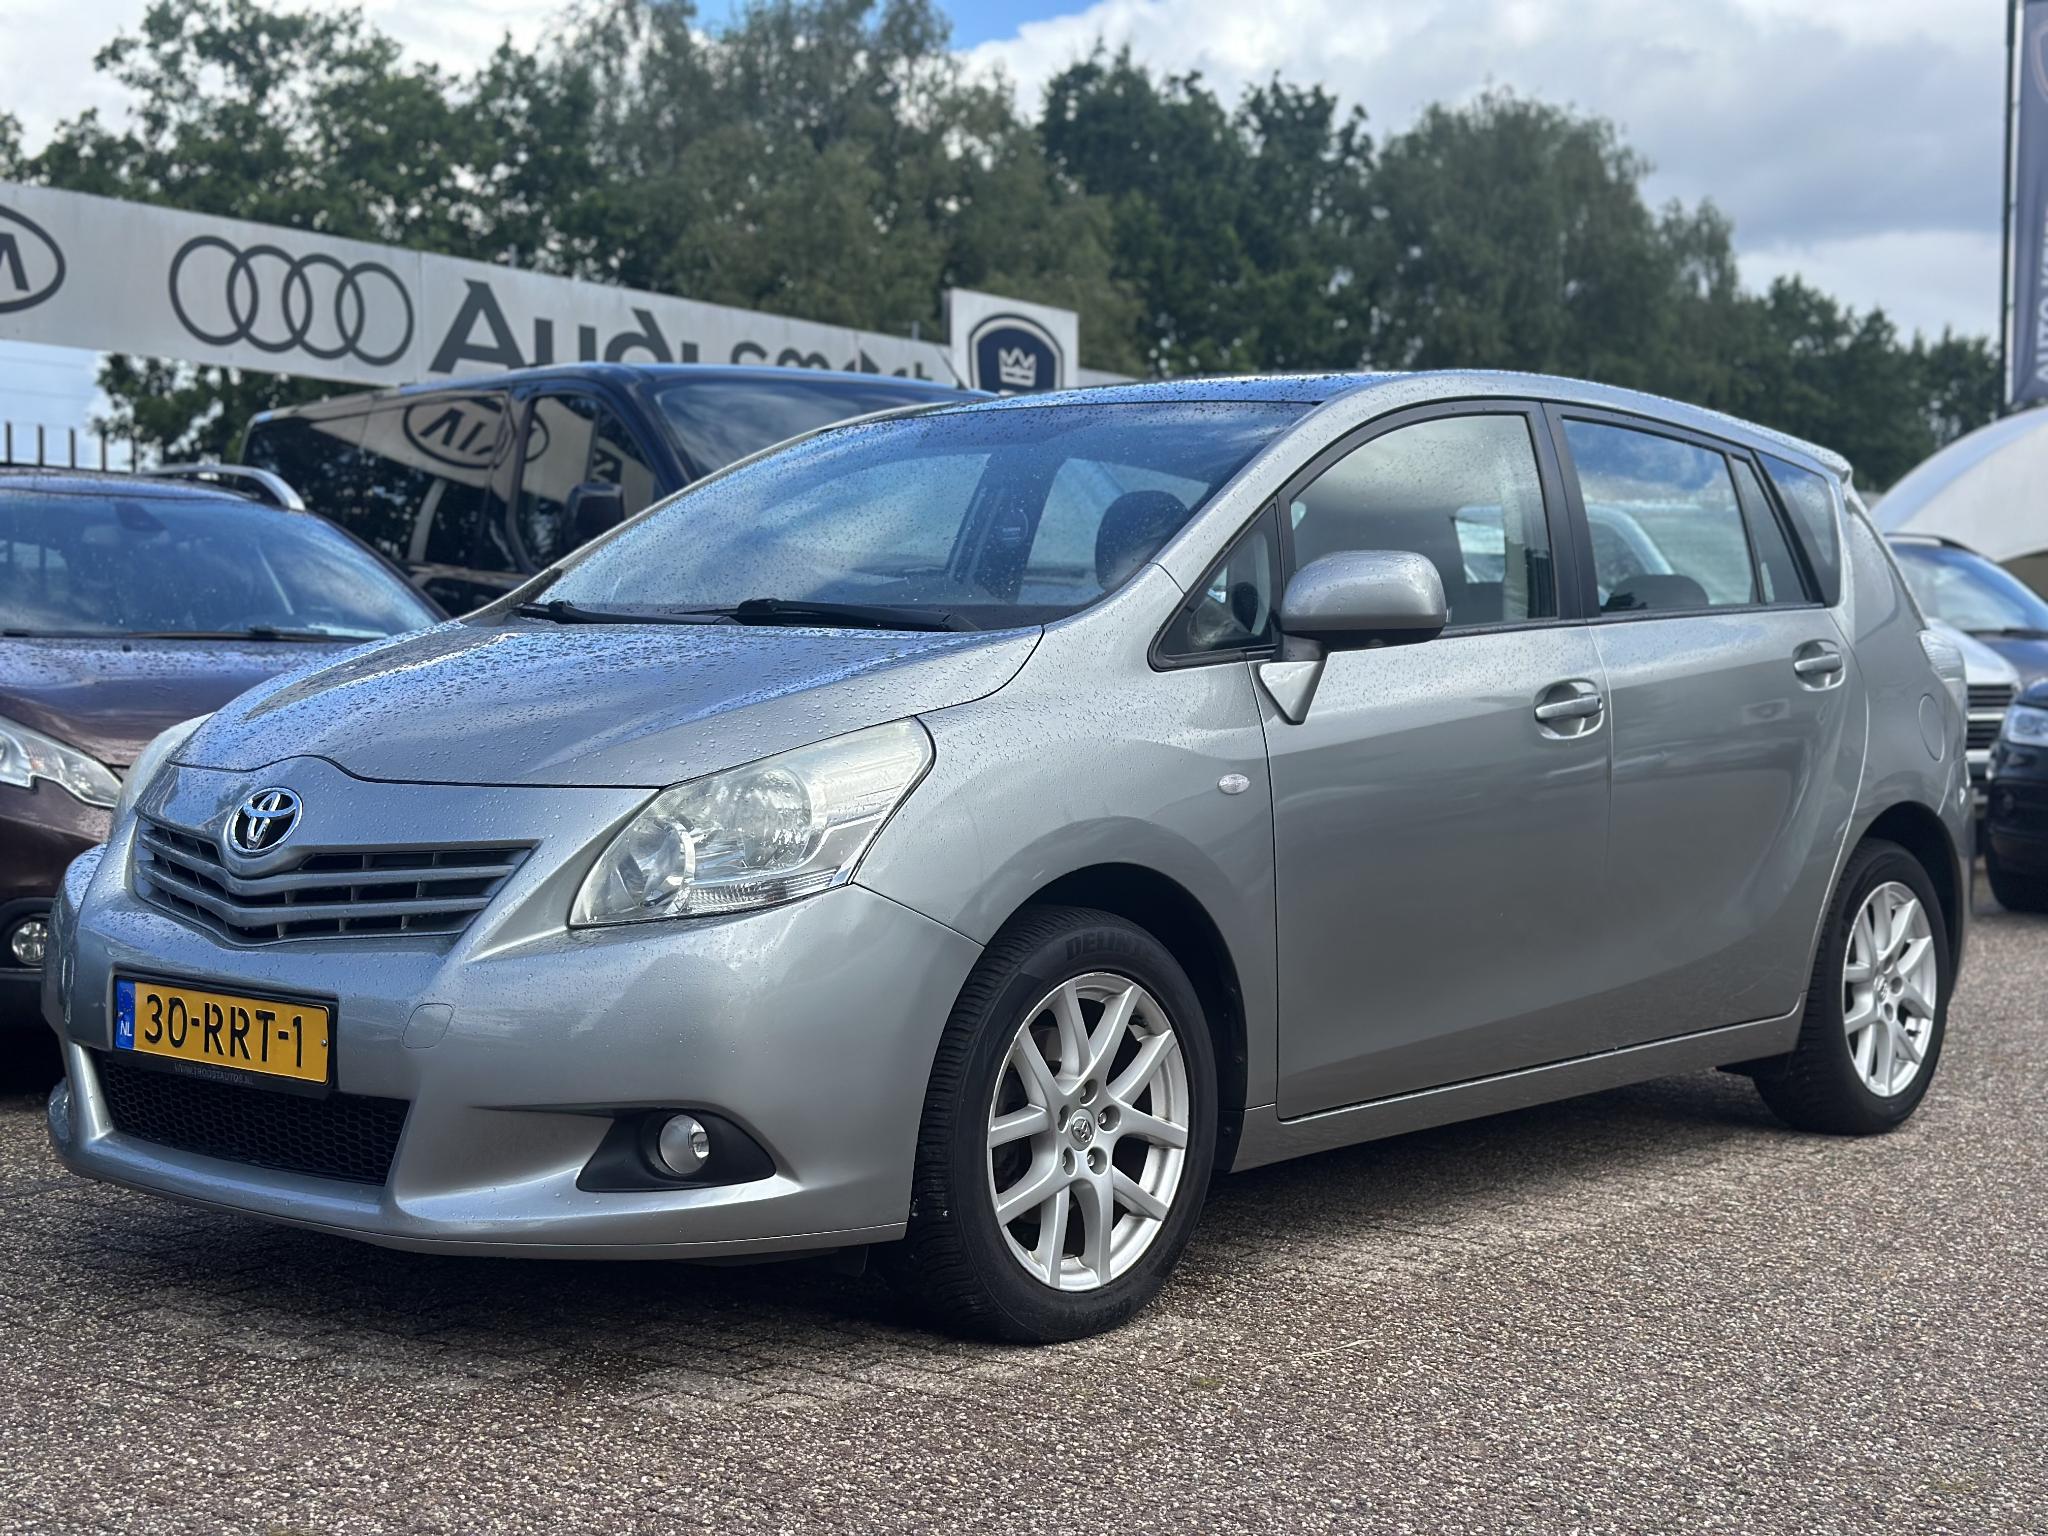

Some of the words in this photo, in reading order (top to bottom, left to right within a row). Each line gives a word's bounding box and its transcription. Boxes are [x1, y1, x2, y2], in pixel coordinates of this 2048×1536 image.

[428, 278, 699, 374] Aud
[119, 1020, 133, 1037] NL
[144, 993, 303, 1068] 30-RRT-1
